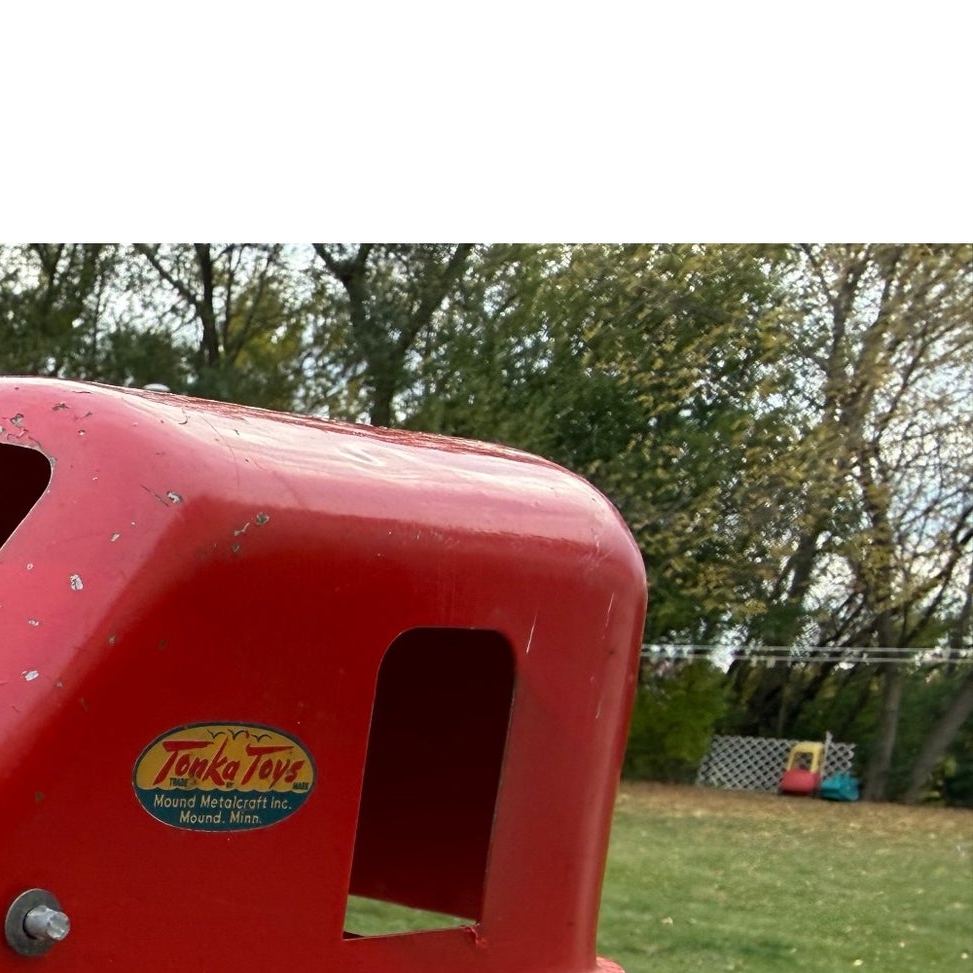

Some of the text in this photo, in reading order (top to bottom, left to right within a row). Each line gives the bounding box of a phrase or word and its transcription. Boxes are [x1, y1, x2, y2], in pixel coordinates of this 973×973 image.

[153, 737, 305, 789] Tonka Toys
[153, 794, 292, 809] Mound Metalcraft Inc.
